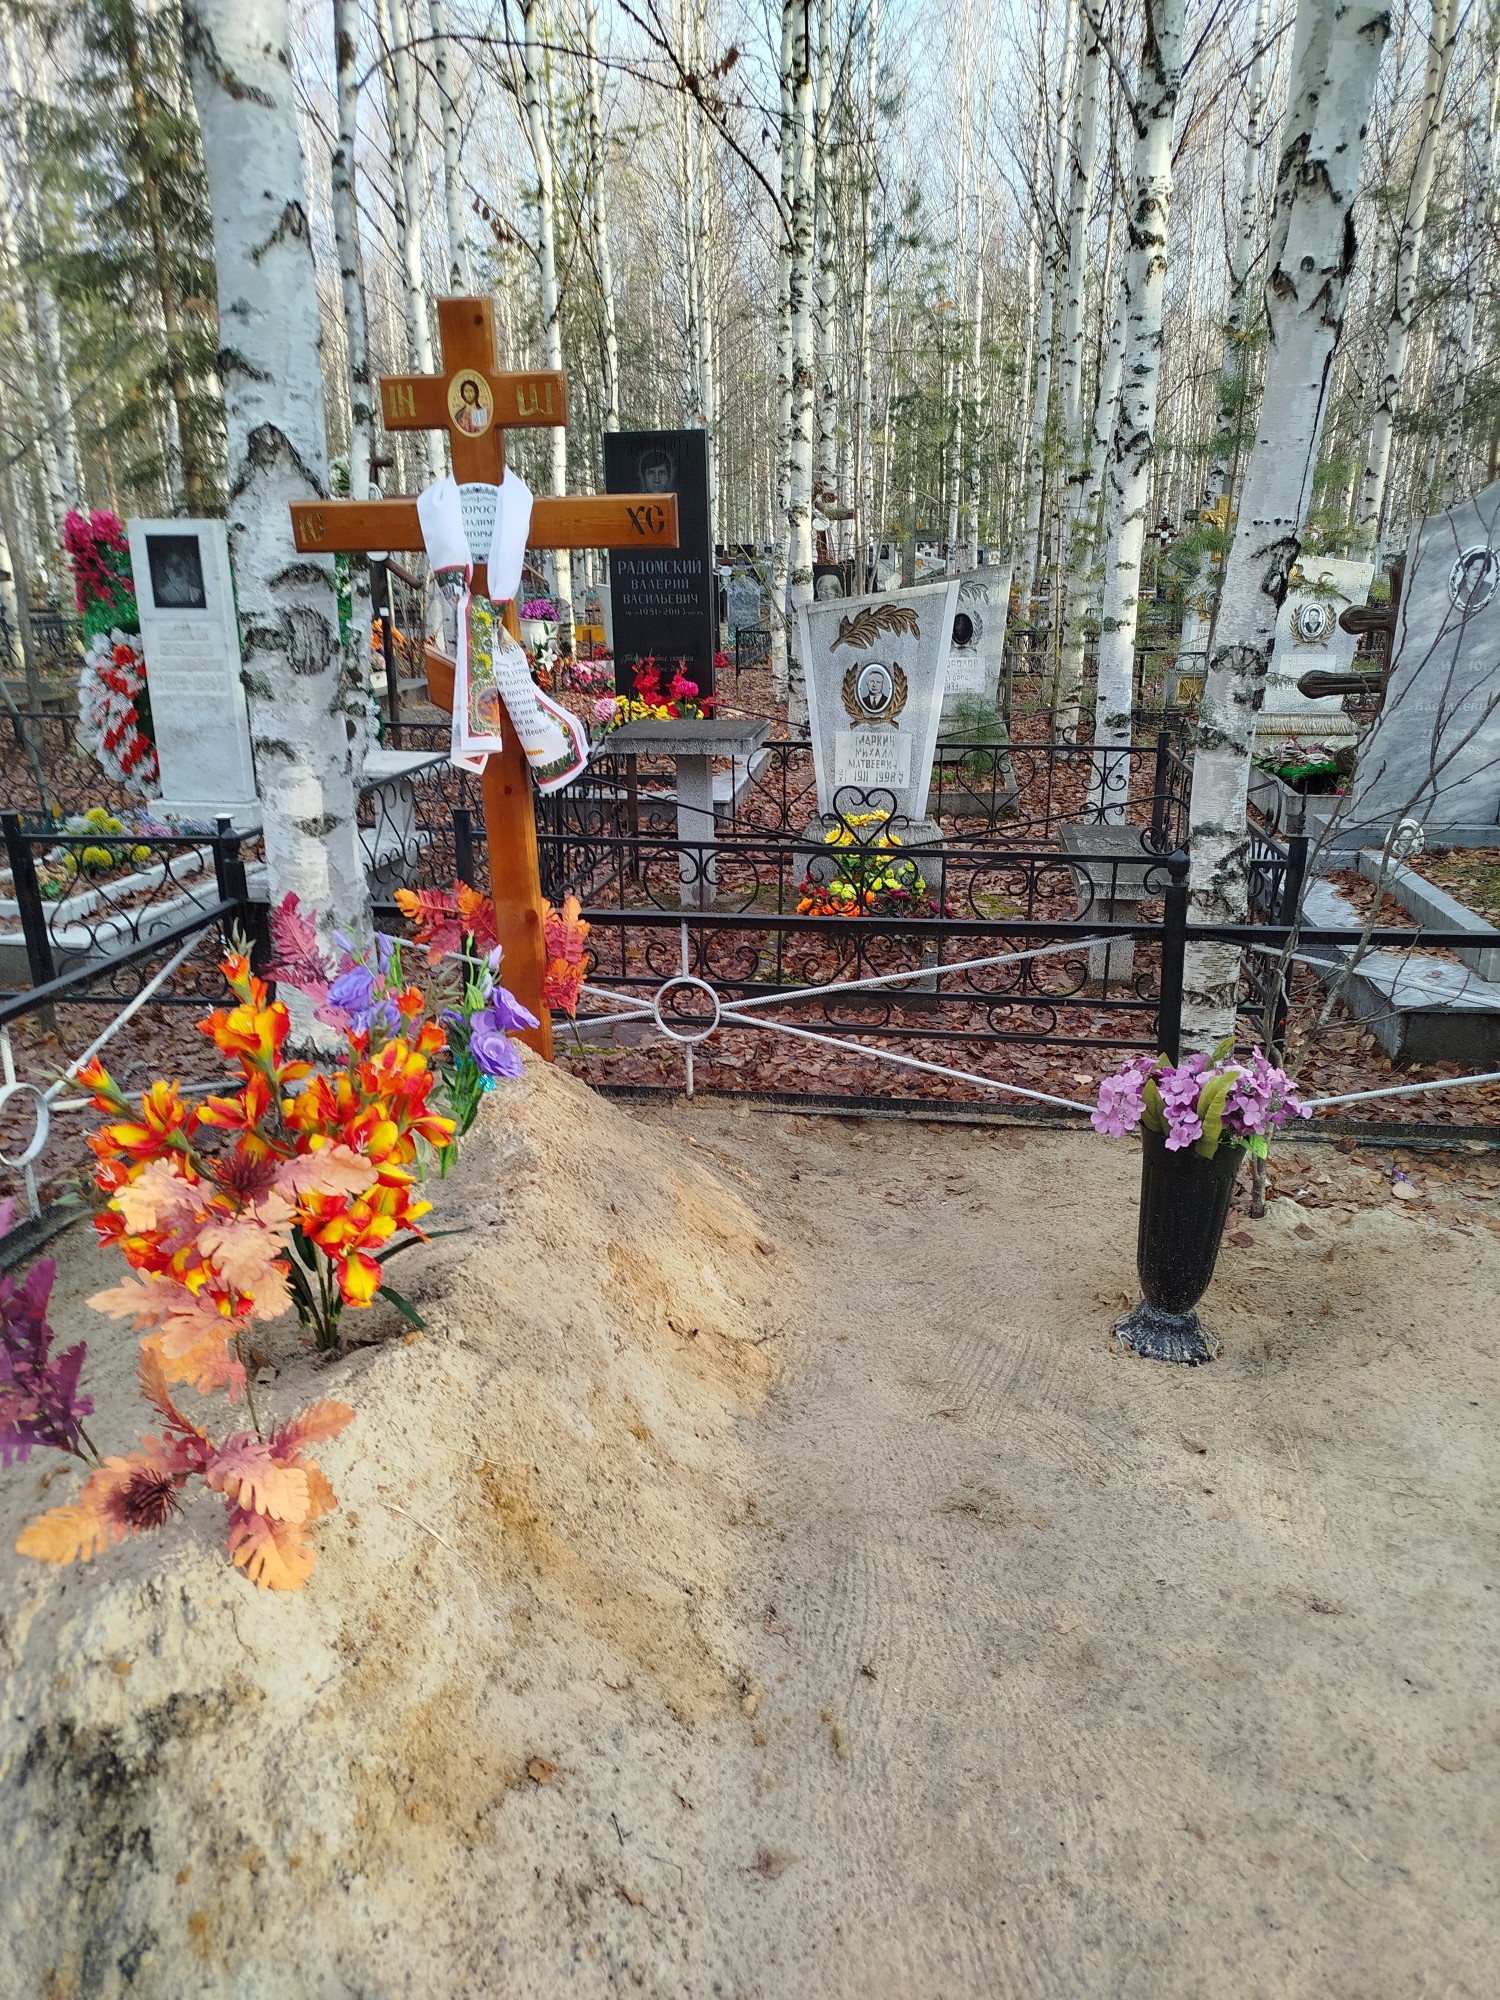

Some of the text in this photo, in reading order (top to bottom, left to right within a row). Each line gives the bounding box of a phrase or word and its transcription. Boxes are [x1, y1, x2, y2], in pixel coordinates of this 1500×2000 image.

[617, 557, 702, 575] РАДОМСКИЙ
[631, 577, 690, 590] ВАЛЕРИЙ
[623, 593, 698, 605] ВАСИЛЬЕВИЧ
[855, 734, 895, 747] МАРКИН
[855, 748, 894, 759] МИХАИЛ
[848, 759, 898, 770] МАТВЕЕВИЧ
